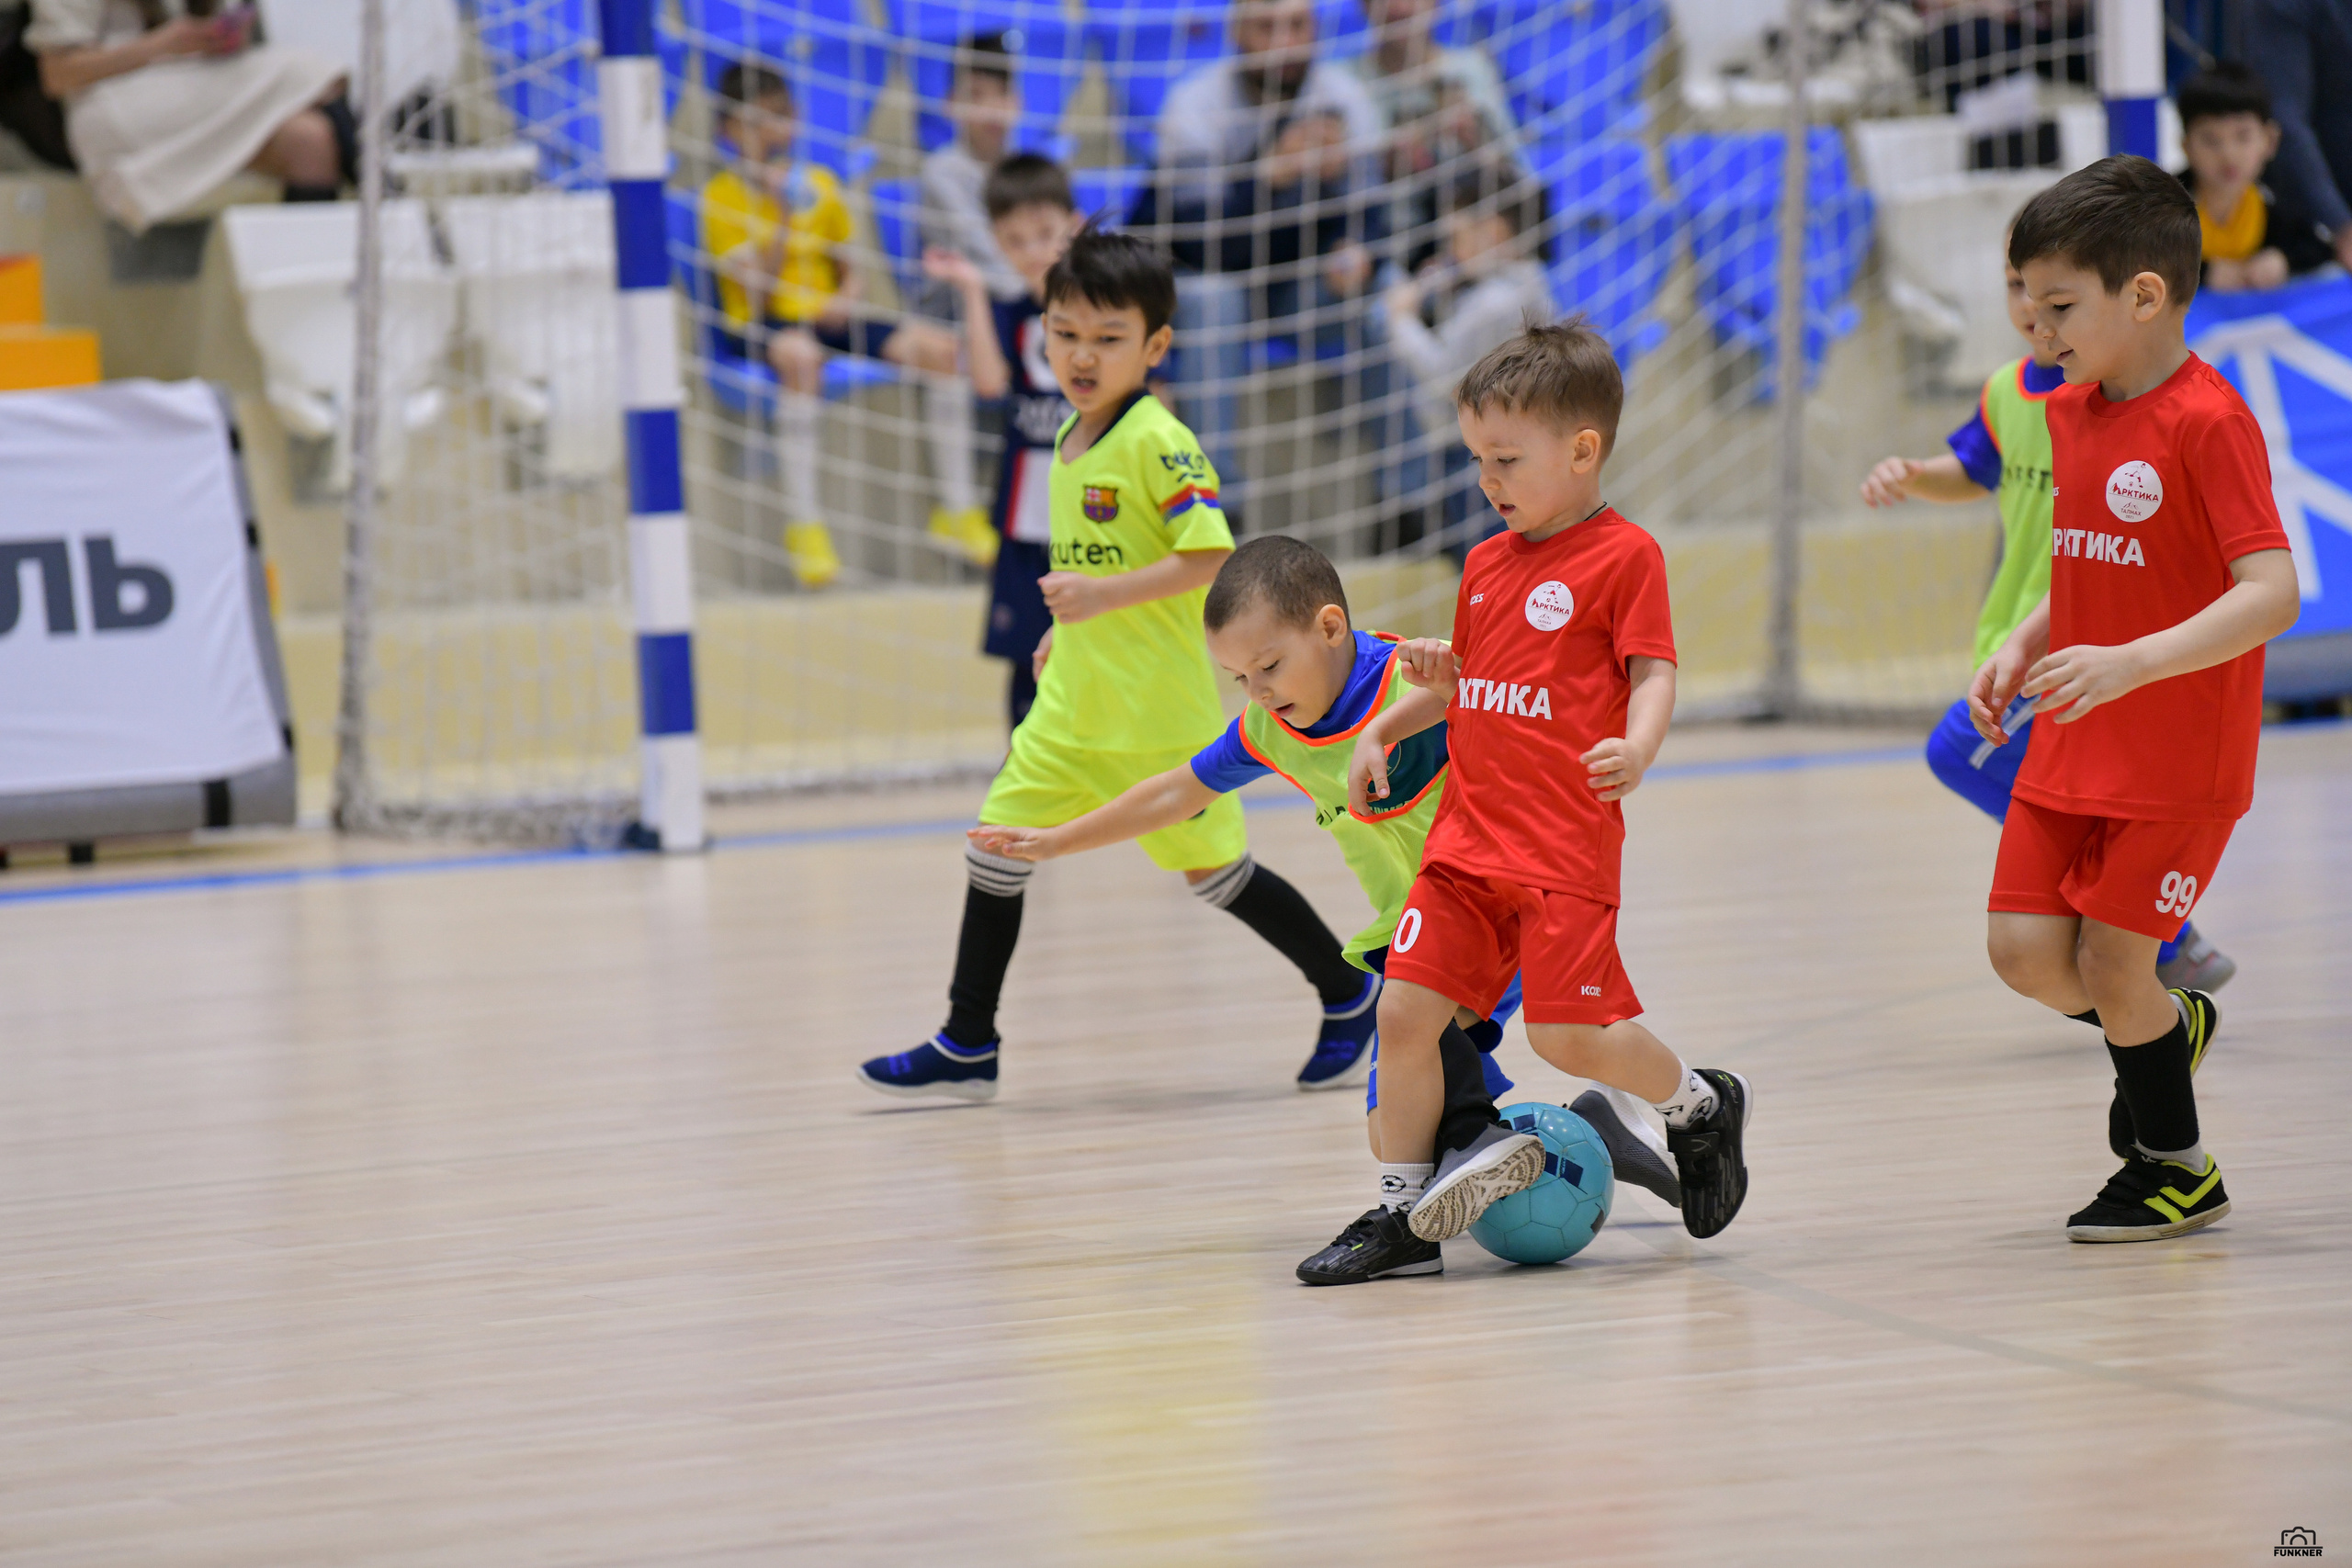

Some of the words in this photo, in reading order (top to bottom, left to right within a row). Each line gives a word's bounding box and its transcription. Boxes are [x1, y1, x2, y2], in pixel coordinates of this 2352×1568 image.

[2110, 482, 2159, 502] АРКТИКА
[2052, 527, 2146, 567] РКТИКА
[1531, 598, 1570, 615] АРКТИКА
[2154, 870, 2198, 919] 99
[1390, 908, 1422, 953] 0
